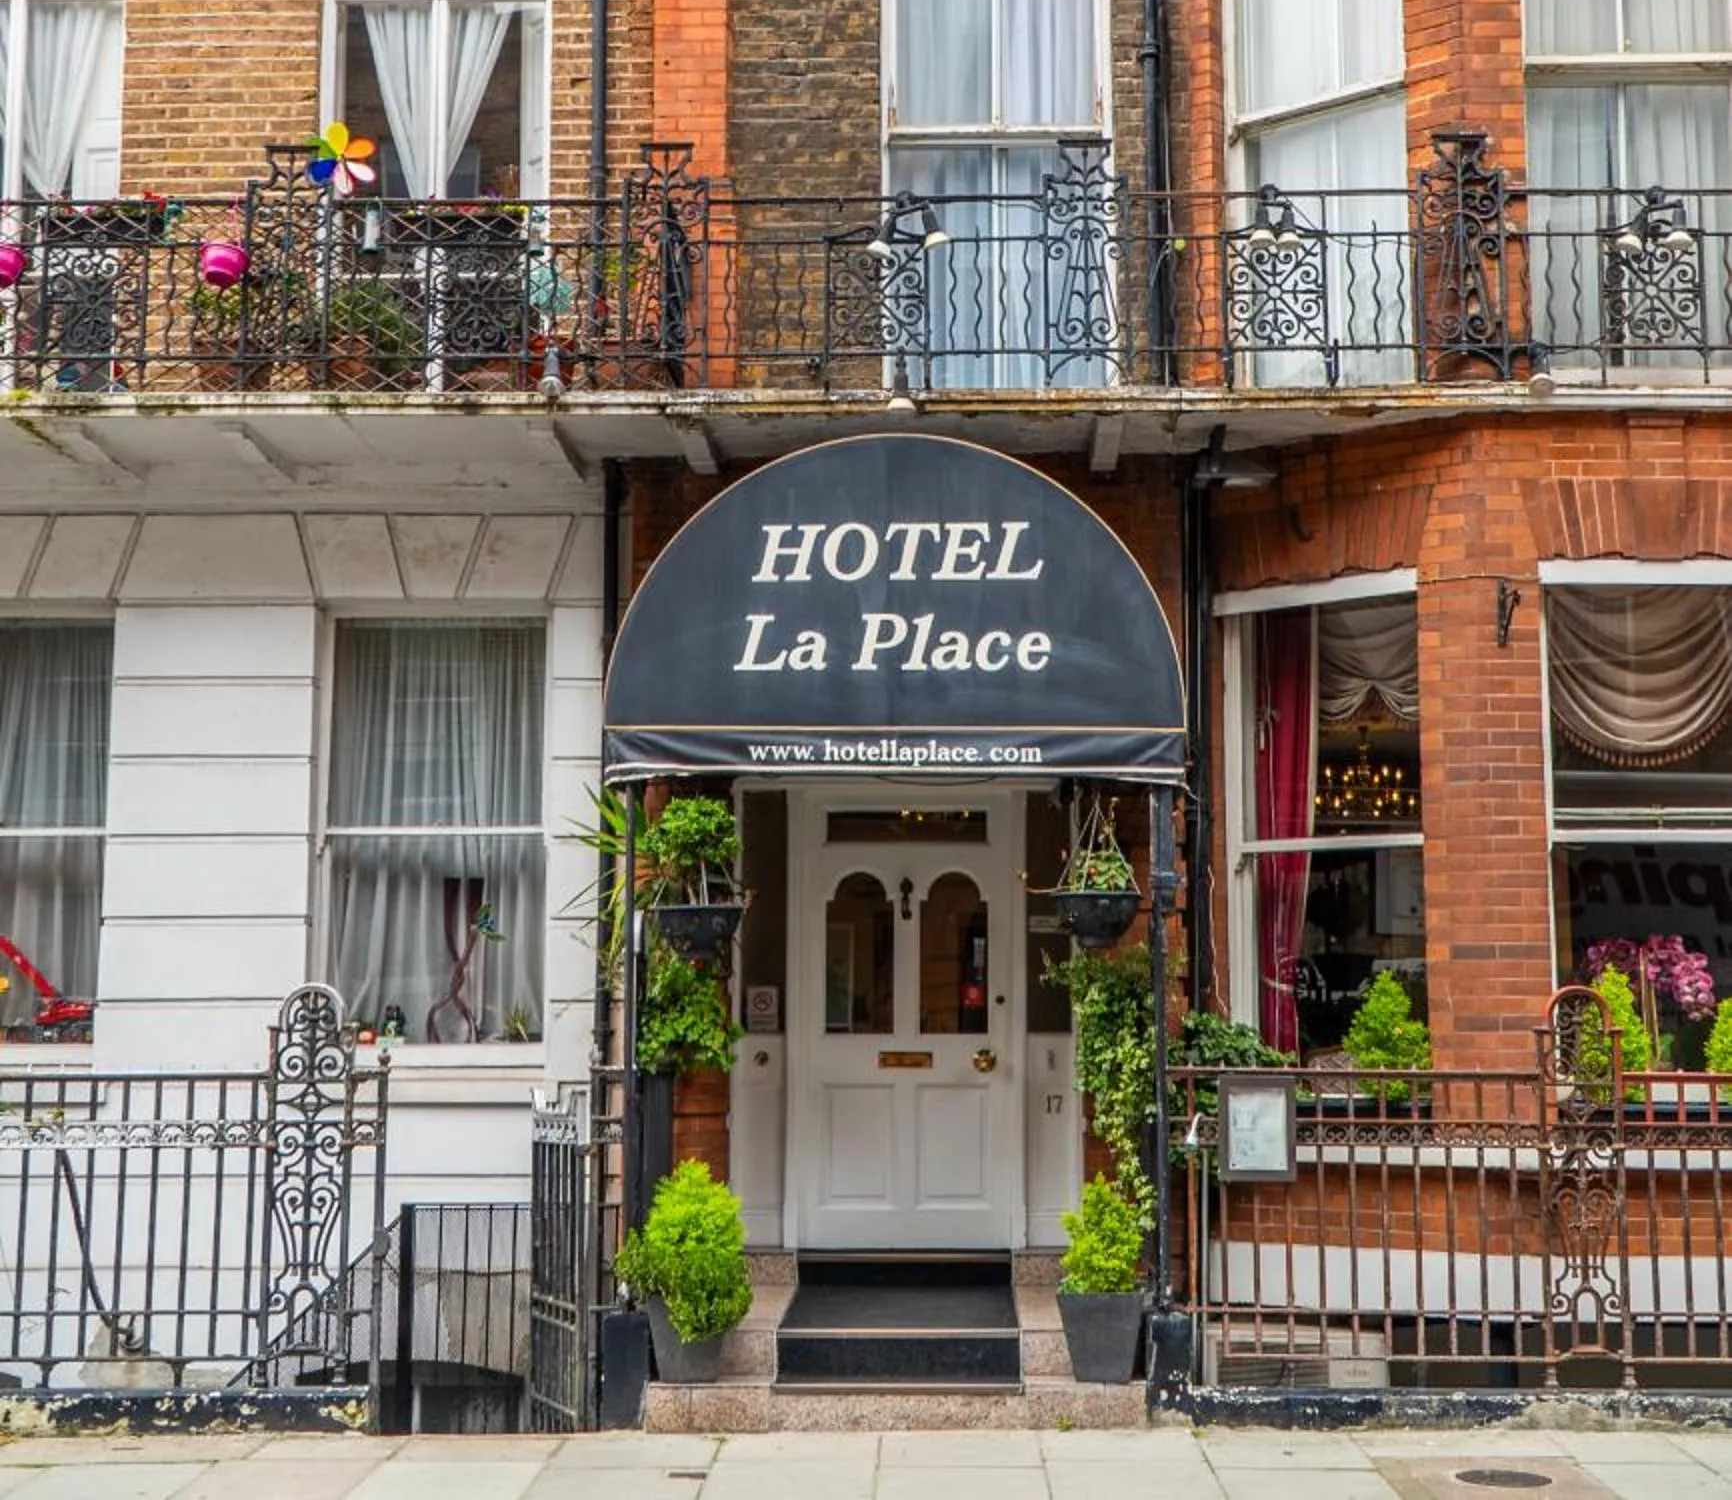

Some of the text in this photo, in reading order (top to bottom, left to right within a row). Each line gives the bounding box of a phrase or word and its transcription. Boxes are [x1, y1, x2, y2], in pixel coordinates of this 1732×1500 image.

[752, 521, 1044, 583] HOTEL
[733, 612, 1053, 672] La Place
[1046, 1094, 1063, 1114] 17
